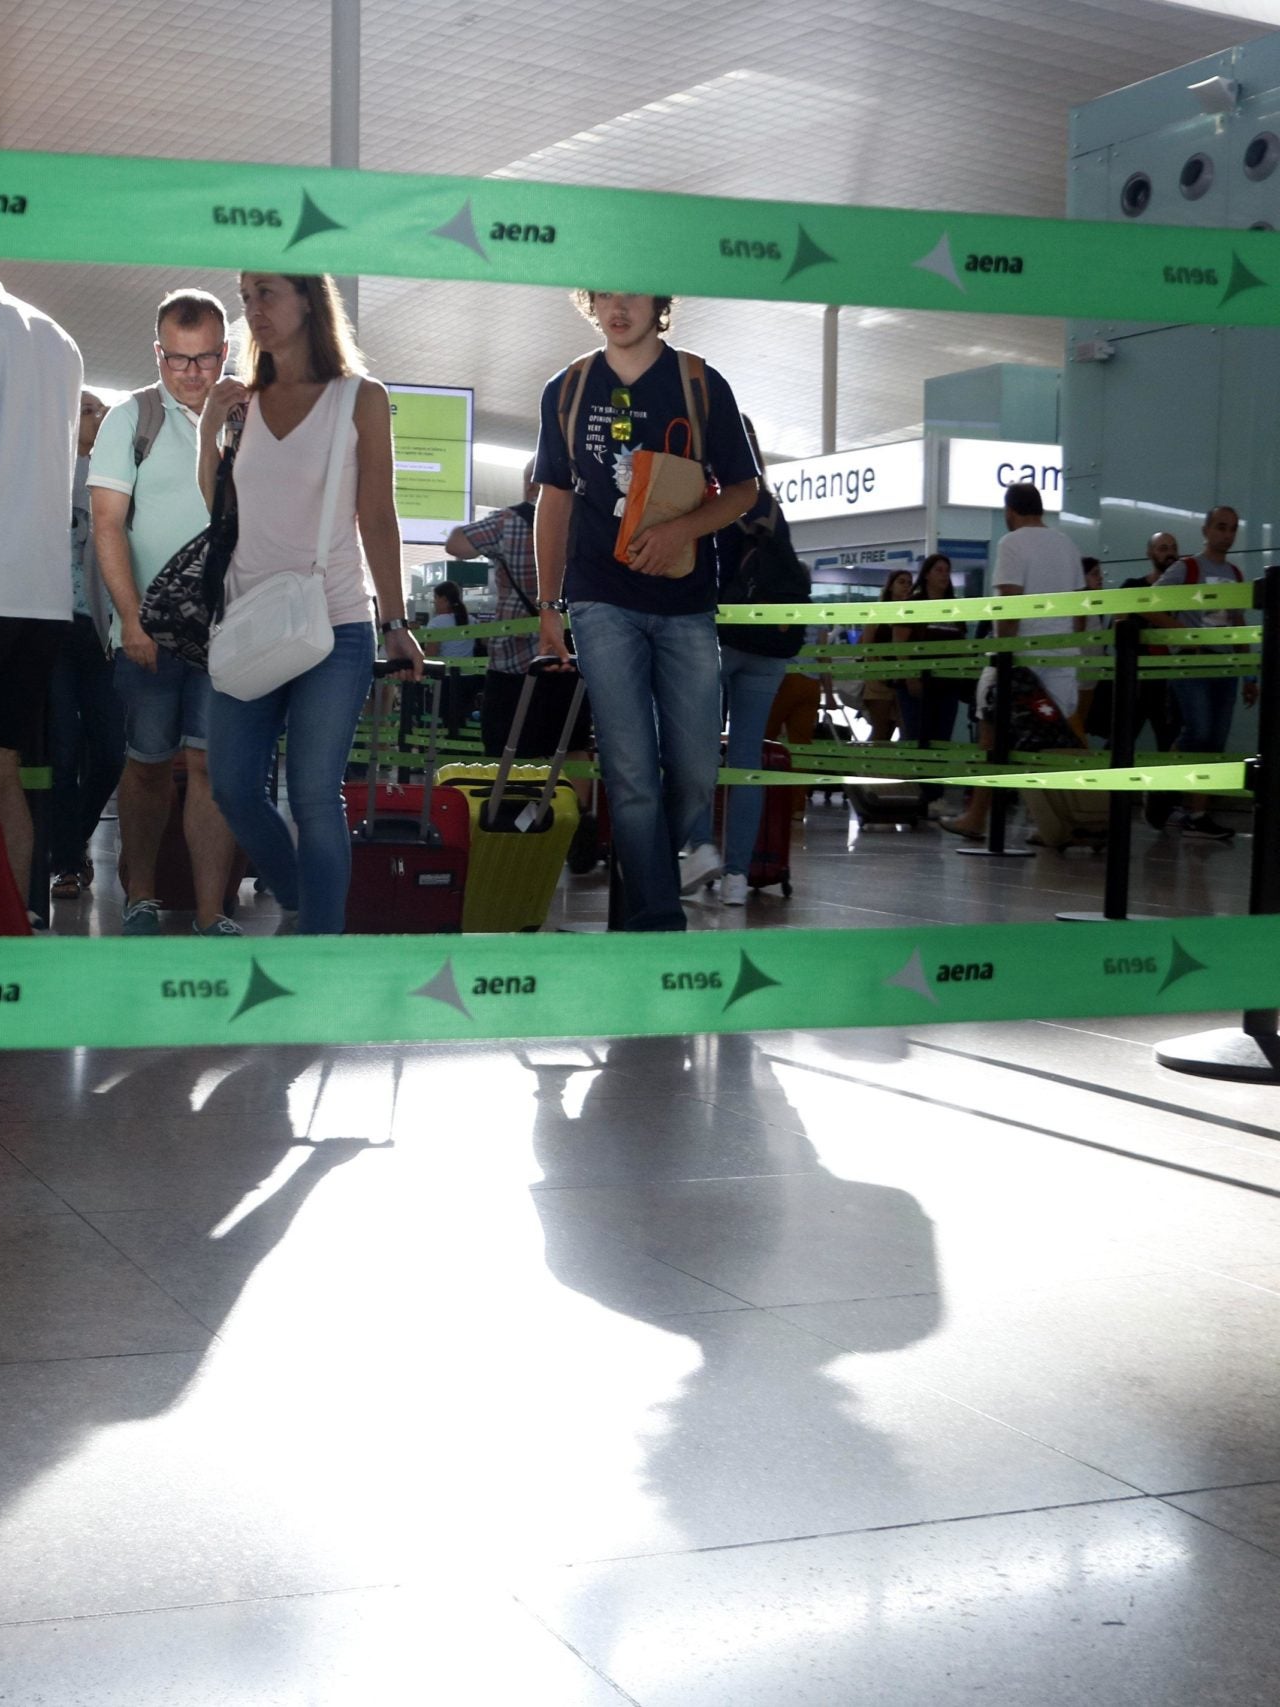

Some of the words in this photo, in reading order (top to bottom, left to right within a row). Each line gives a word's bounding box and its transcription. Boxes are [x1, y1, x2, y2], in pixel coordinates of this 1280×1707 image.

[490, 221, 557, 245] aena
[964, 254, 1024, 275] aena
[773, 467, 875, 504] xchange
[839, 552, 858, 565] TAX
[860, 549, 886, 563] FREE
[936, 962, 995, 983] aena
[472, 975, 537, 996] aena
